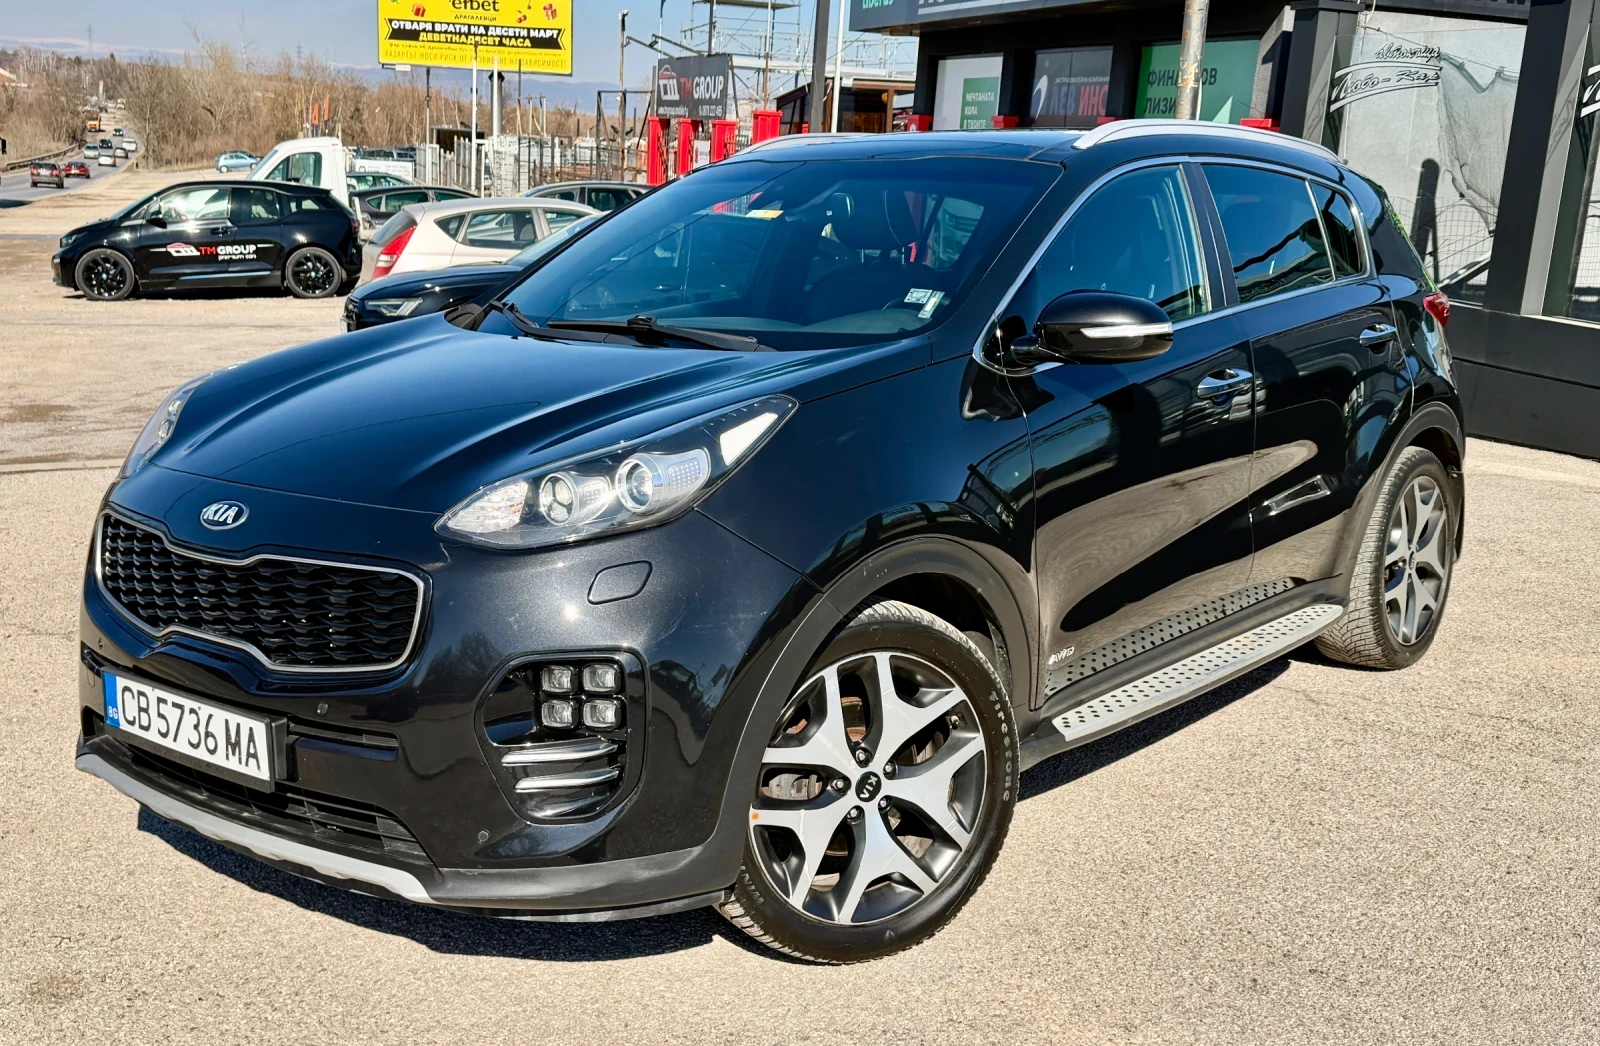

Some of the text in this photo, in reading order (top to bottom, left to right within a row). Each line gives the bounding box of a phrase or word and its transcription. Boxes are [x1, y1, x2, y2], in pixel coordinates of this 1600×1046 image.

[454, 14, 497, 22] ДРАГАЛЕВЦИ
[391, 20, 559, 39] ОТВАРЯ ВРАТИ НА ДЕСЕТИ МАРТ
[502, 37, 532, 48] ЧАСА
[1147, 67, 1218, 88] ФИНОВ
[1049, 84, 1077, 116] ЛЕВ
[1144, 97, 1177, 115] ЛИЗИ
[202, 503, 239, 524] KIA
[108, 705, 119, 720] BG
[121, 685, 262, 772] CB 5736 MA
[859, 774, 879, 799] KIA
